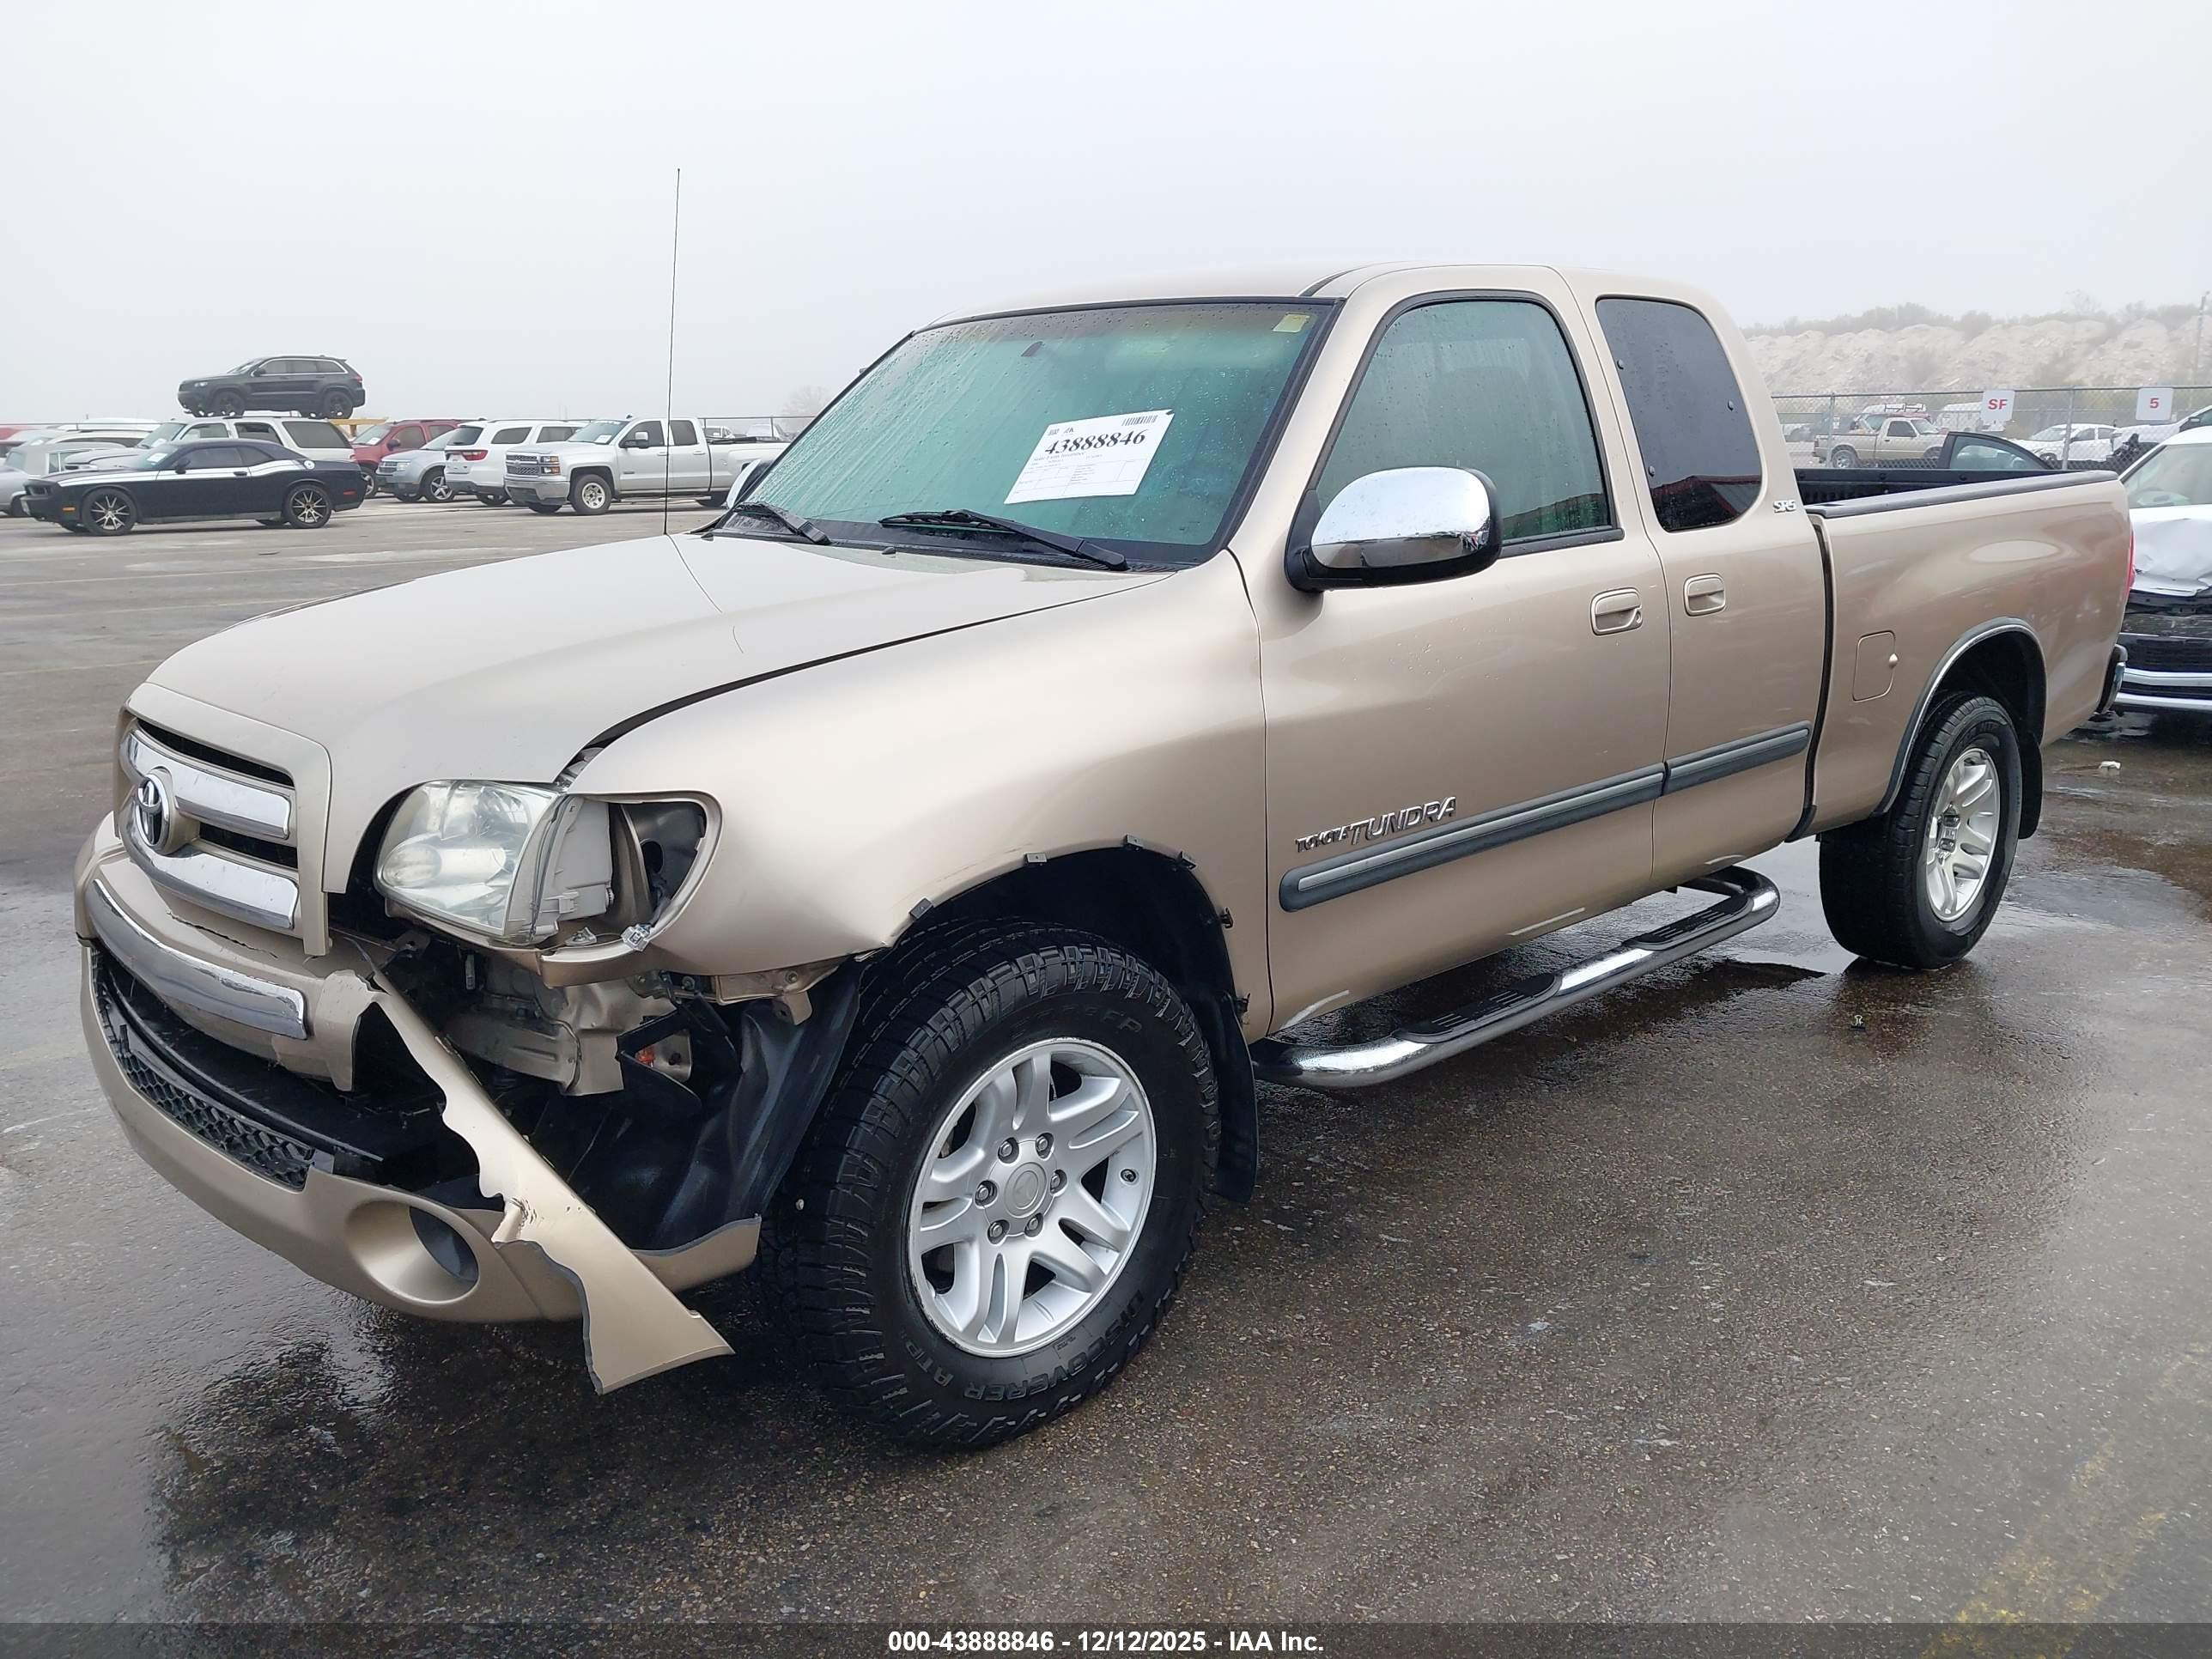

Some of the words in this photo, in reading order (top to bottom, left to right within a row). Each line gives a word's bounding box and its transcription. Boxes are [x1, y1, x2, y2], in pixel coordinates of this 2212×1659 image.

[1988, 398, 2008, 410] SF
[2149, 398, 2160, 409] 5
[1044, 428, 1149, 454] 43888846
[1772, 500, 1796, 513] SR5
[1349, 796, 1456, 845] TUNDRA
